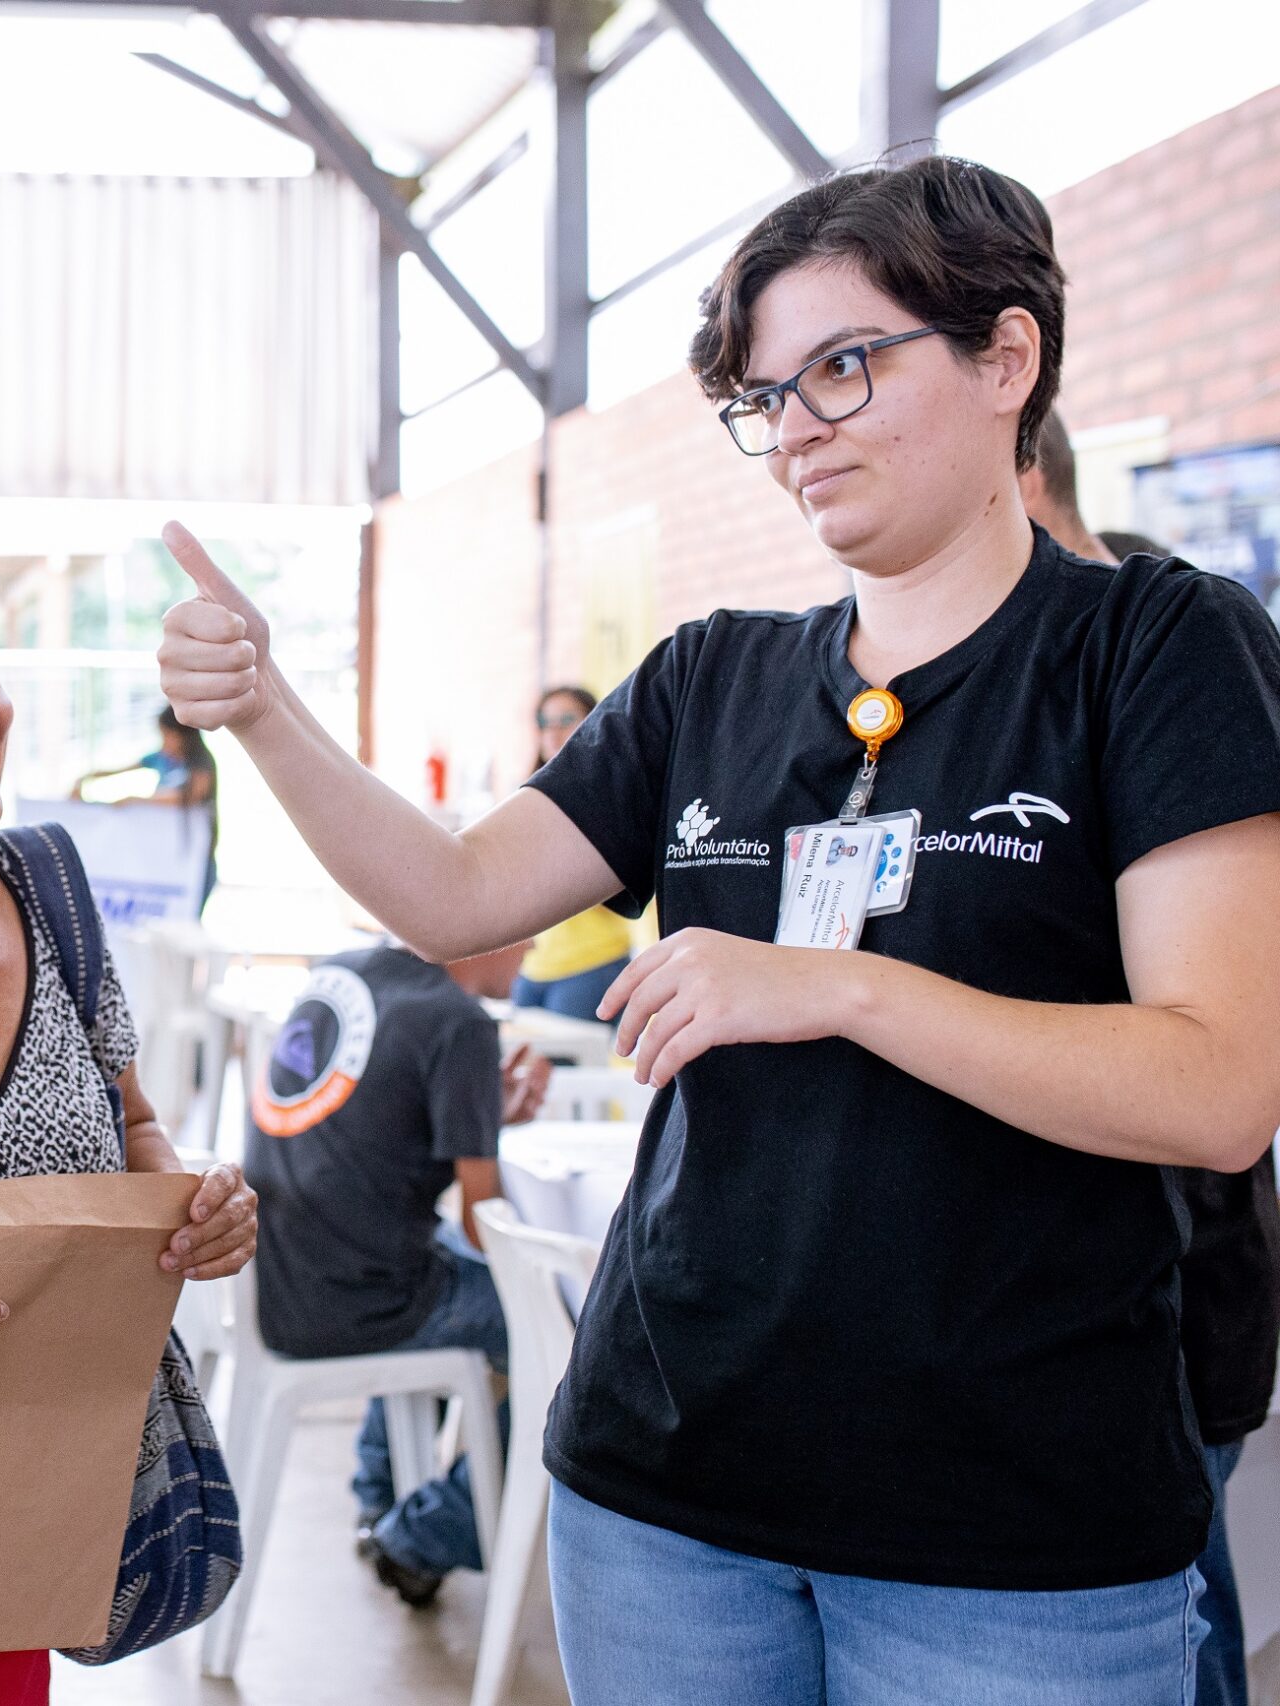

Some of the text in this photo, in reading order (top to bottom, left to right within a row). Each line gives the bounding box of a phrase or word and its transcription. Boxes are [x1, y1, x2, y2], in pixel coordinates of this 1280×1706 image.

[666, 838, 770, 860] Pró Voluntário
[720, 856, 770, 867] transformação
[798, 833, 823, 898] Milena Ruiz
[821, 879, 845, 943] ArcelorMittal
